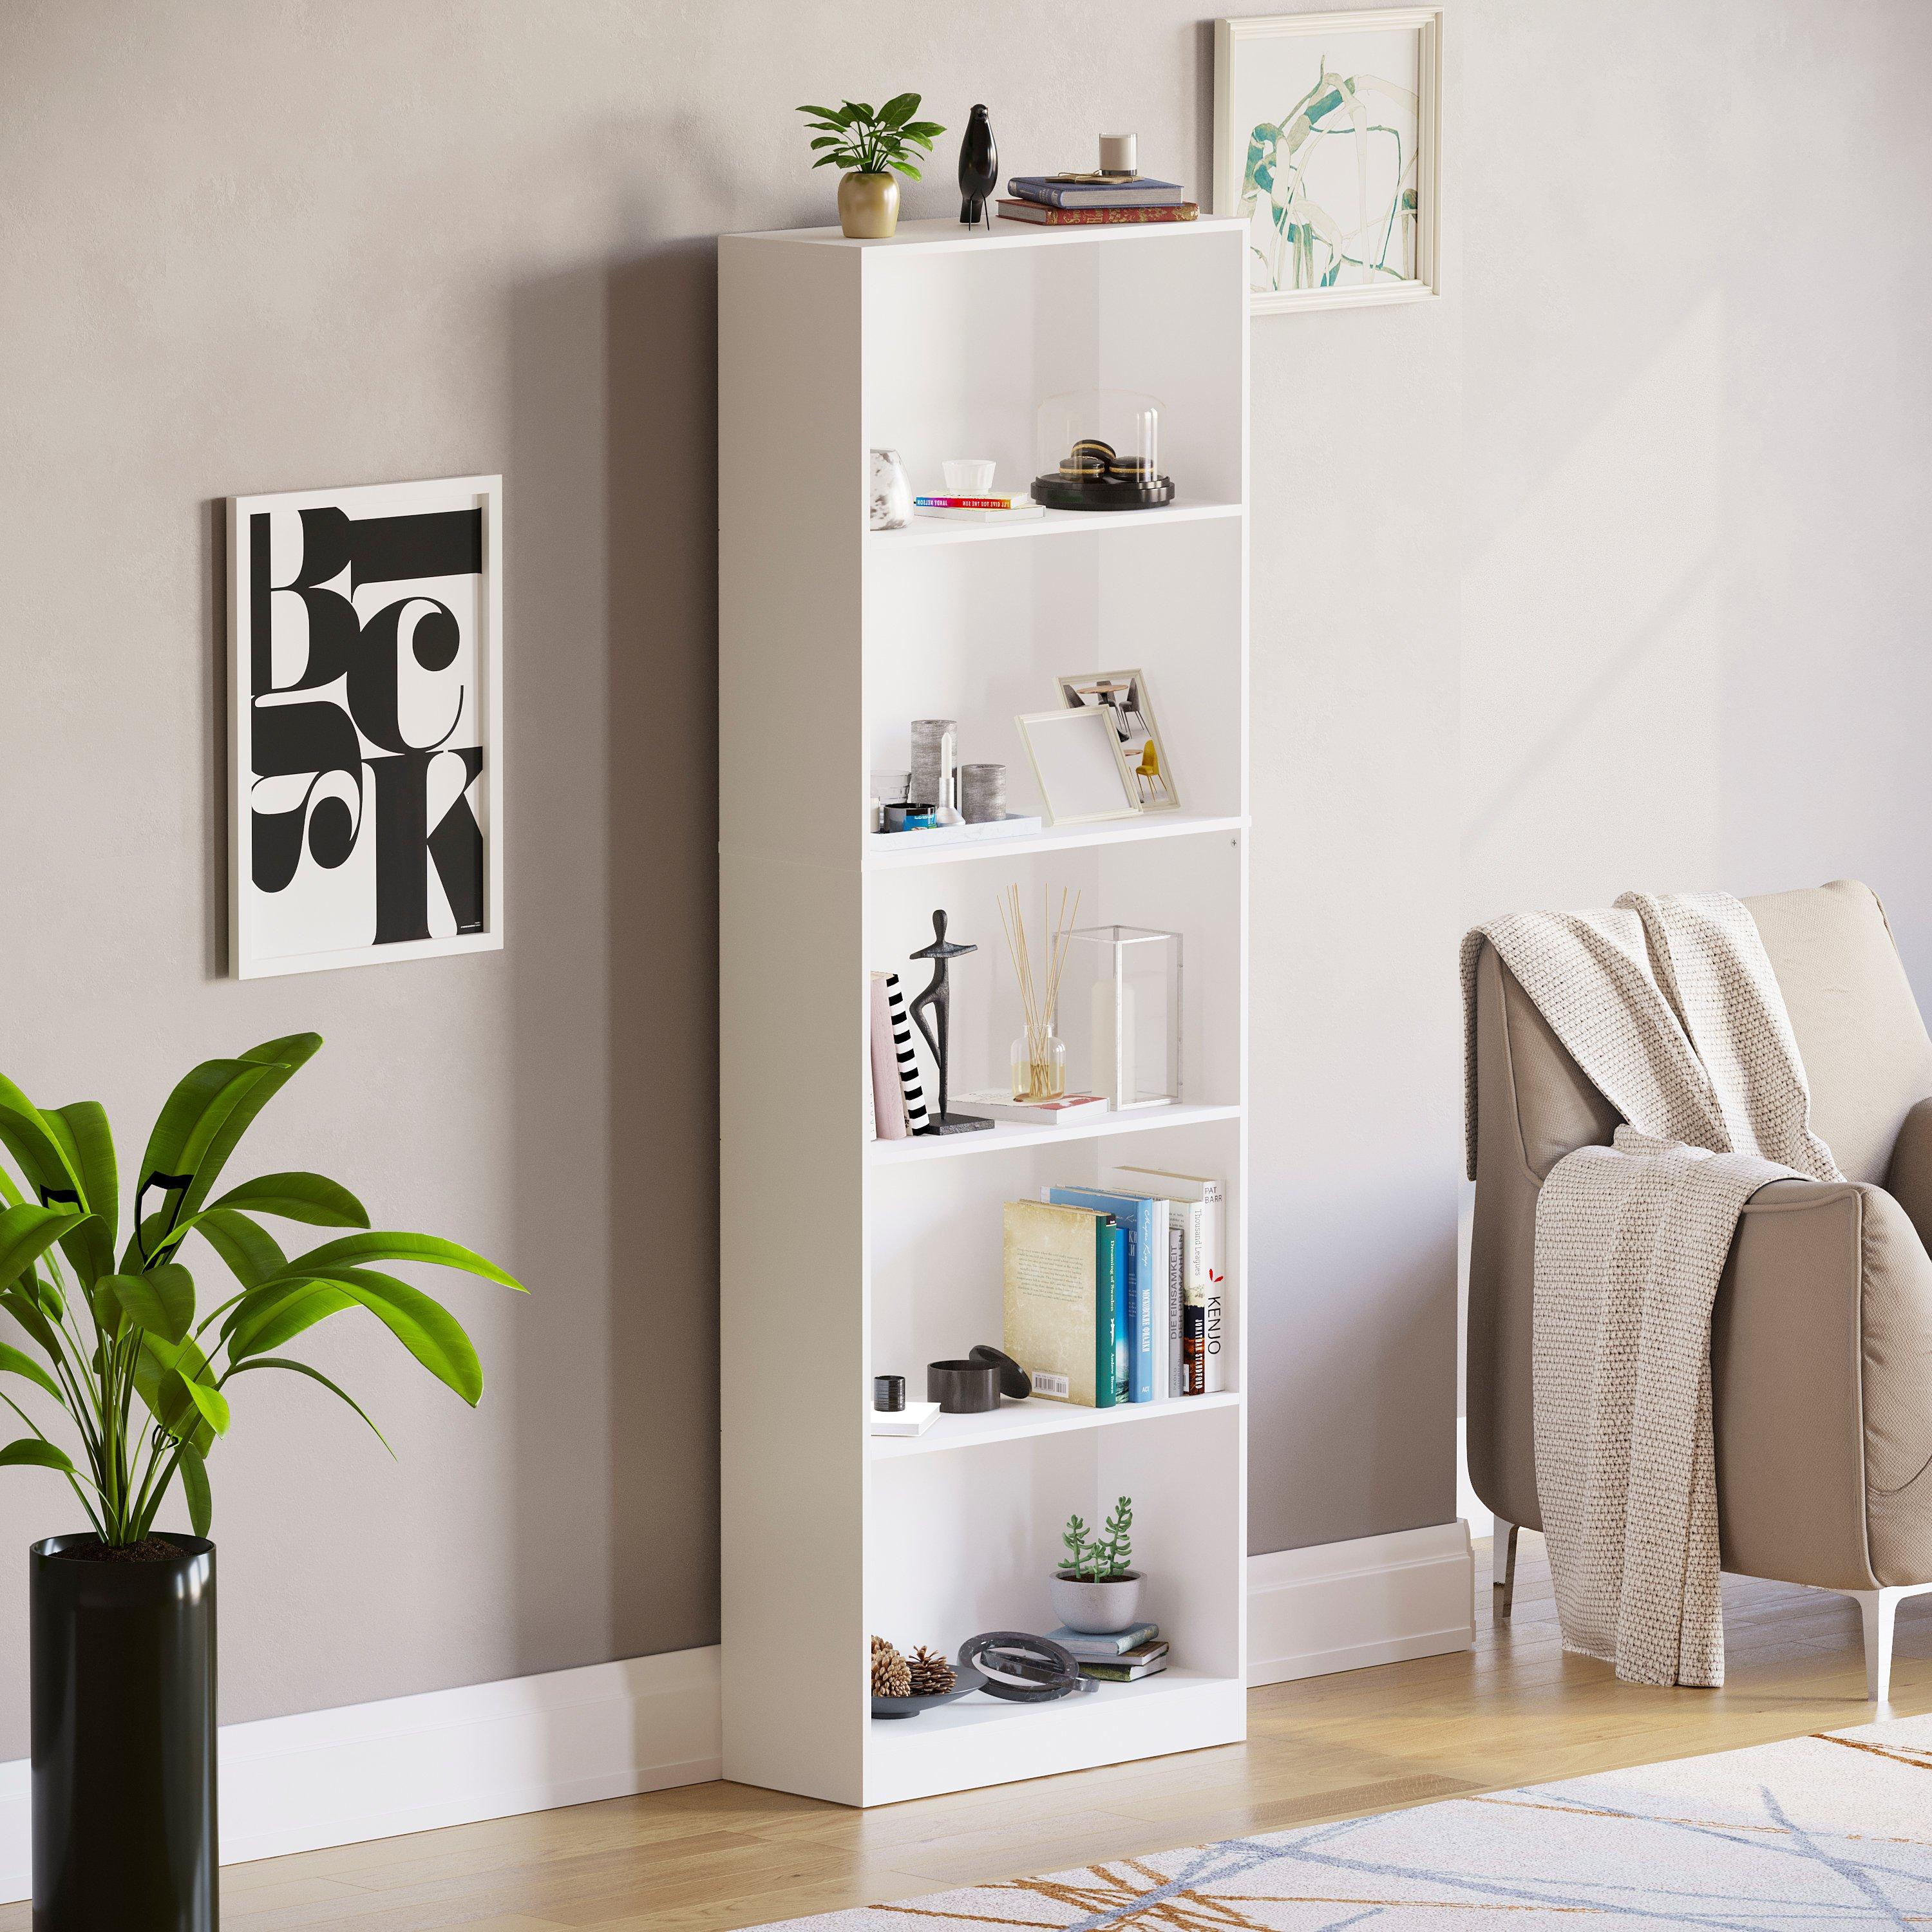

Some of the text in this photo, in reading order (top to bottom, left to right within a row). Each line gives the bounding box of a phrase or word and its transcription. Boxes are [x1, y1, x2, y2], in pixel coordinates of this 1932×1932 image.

[1205, 1195, 1222, 1204] BARR
[1193, 1247, 1202, 1276] Leagues
[1208, 1296, 1221, 1354] KENJO
[1195, 1319, 1203, 1389] JONATHAN STANDFORD
